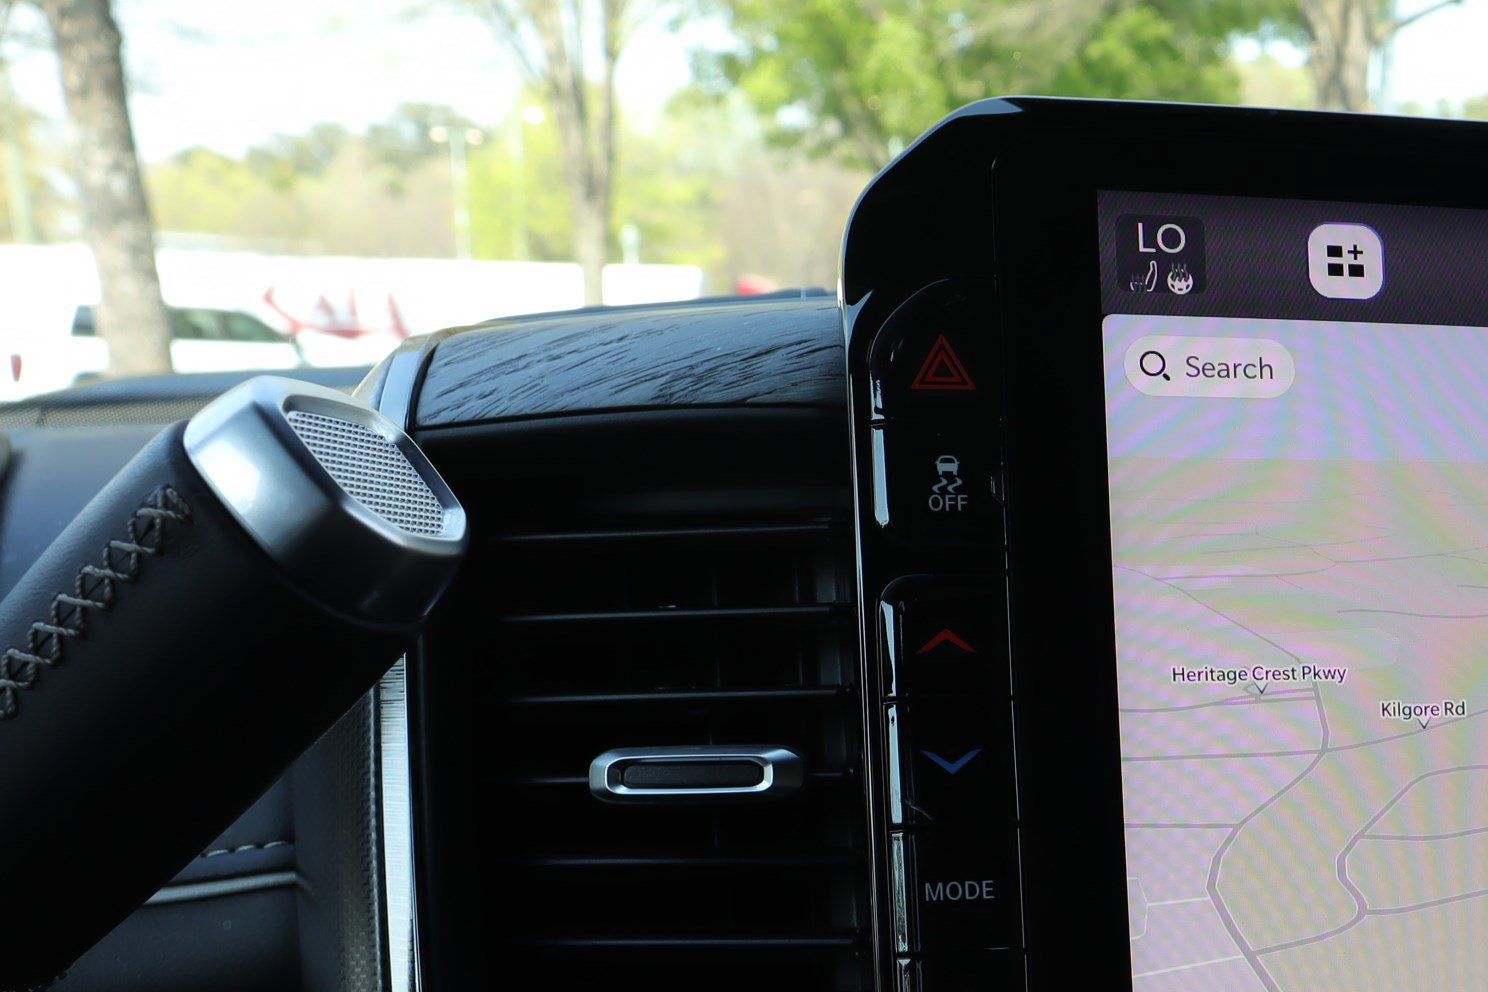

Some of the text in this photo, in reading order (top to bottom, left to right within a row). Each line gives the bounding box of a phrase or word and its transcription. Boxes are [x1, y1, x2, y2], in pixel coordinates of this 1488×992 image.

[1136, 221, 1187, 254] LO
[1184, 354, 1275, 381] Search
[928, 494, 969, 512] OFF
[1171, 663, 1348, 685] Heritage Crest Pkwy
[1380, 699, 1467, 721] Kilgore Rd
[924, 880, 995, 902] MODE
